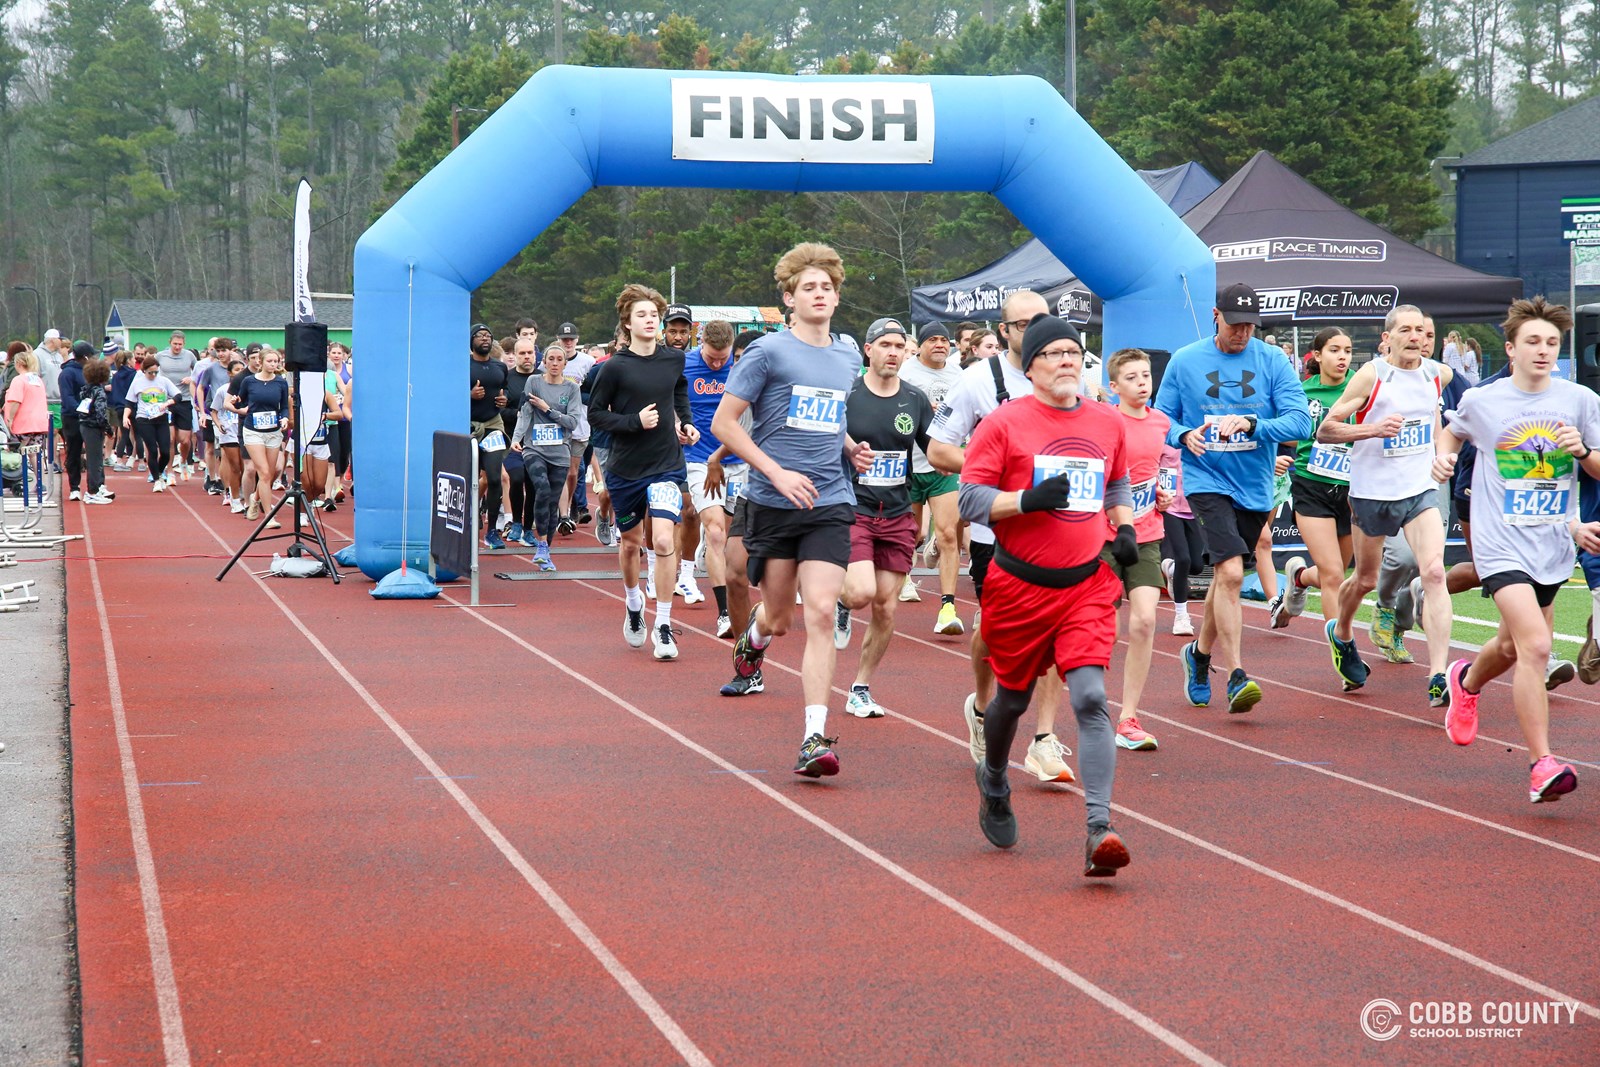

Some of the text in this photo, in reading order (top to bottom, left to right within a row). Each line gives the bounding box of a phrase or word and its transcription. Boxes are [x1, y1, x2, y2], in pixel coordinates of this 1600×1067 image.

[689, 95, 918, 142] FINISH
[1218, 246, 1266, 258] ELITE
[1273, 242, 1316, 253] RACE
[975, 287, 998, 311] Cross
[1259, 295, 1296, 309] ELITE
[1300, 292, 1338, 307] RACE
[796, 396, 839, 423] 5474
[1227, 402, 1265, 410] ARMOUR
[535, 428, 559, 441] 5561
[1390, 425, 1427, 448] 5581
[866, 459, 905, 478] 5515
[1314, 448, 1350, 472] 5776
[1043, 467, 1097, 499] 99
[651, 485, 679, 508] 5684
[1512, 491, 1563, 515] 5424
